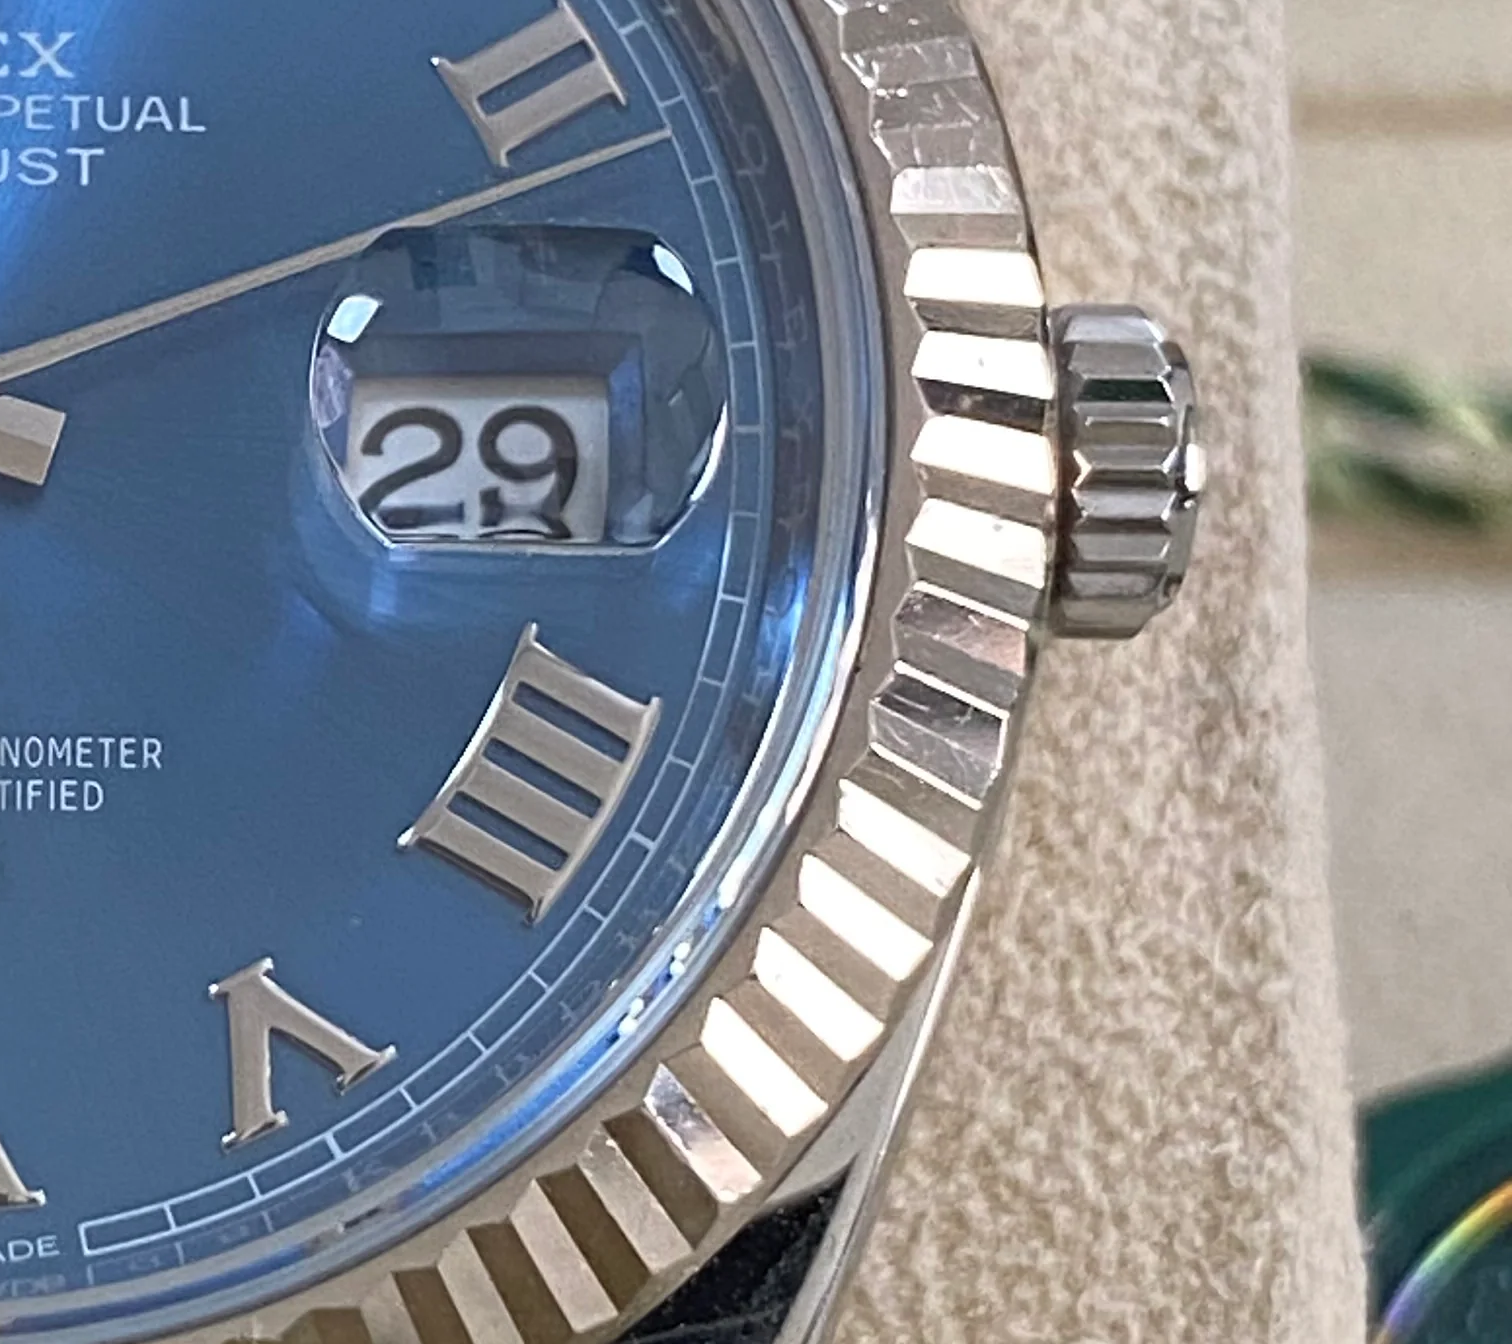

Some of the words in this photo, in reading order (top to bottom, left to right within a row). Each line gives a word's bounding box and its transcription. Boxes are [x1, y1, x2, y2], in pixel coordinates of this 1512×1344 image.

[358, 404, 580, 540] 29
[397, 623, 663, 925] IIII
[208, 957, 396, 1154] V
